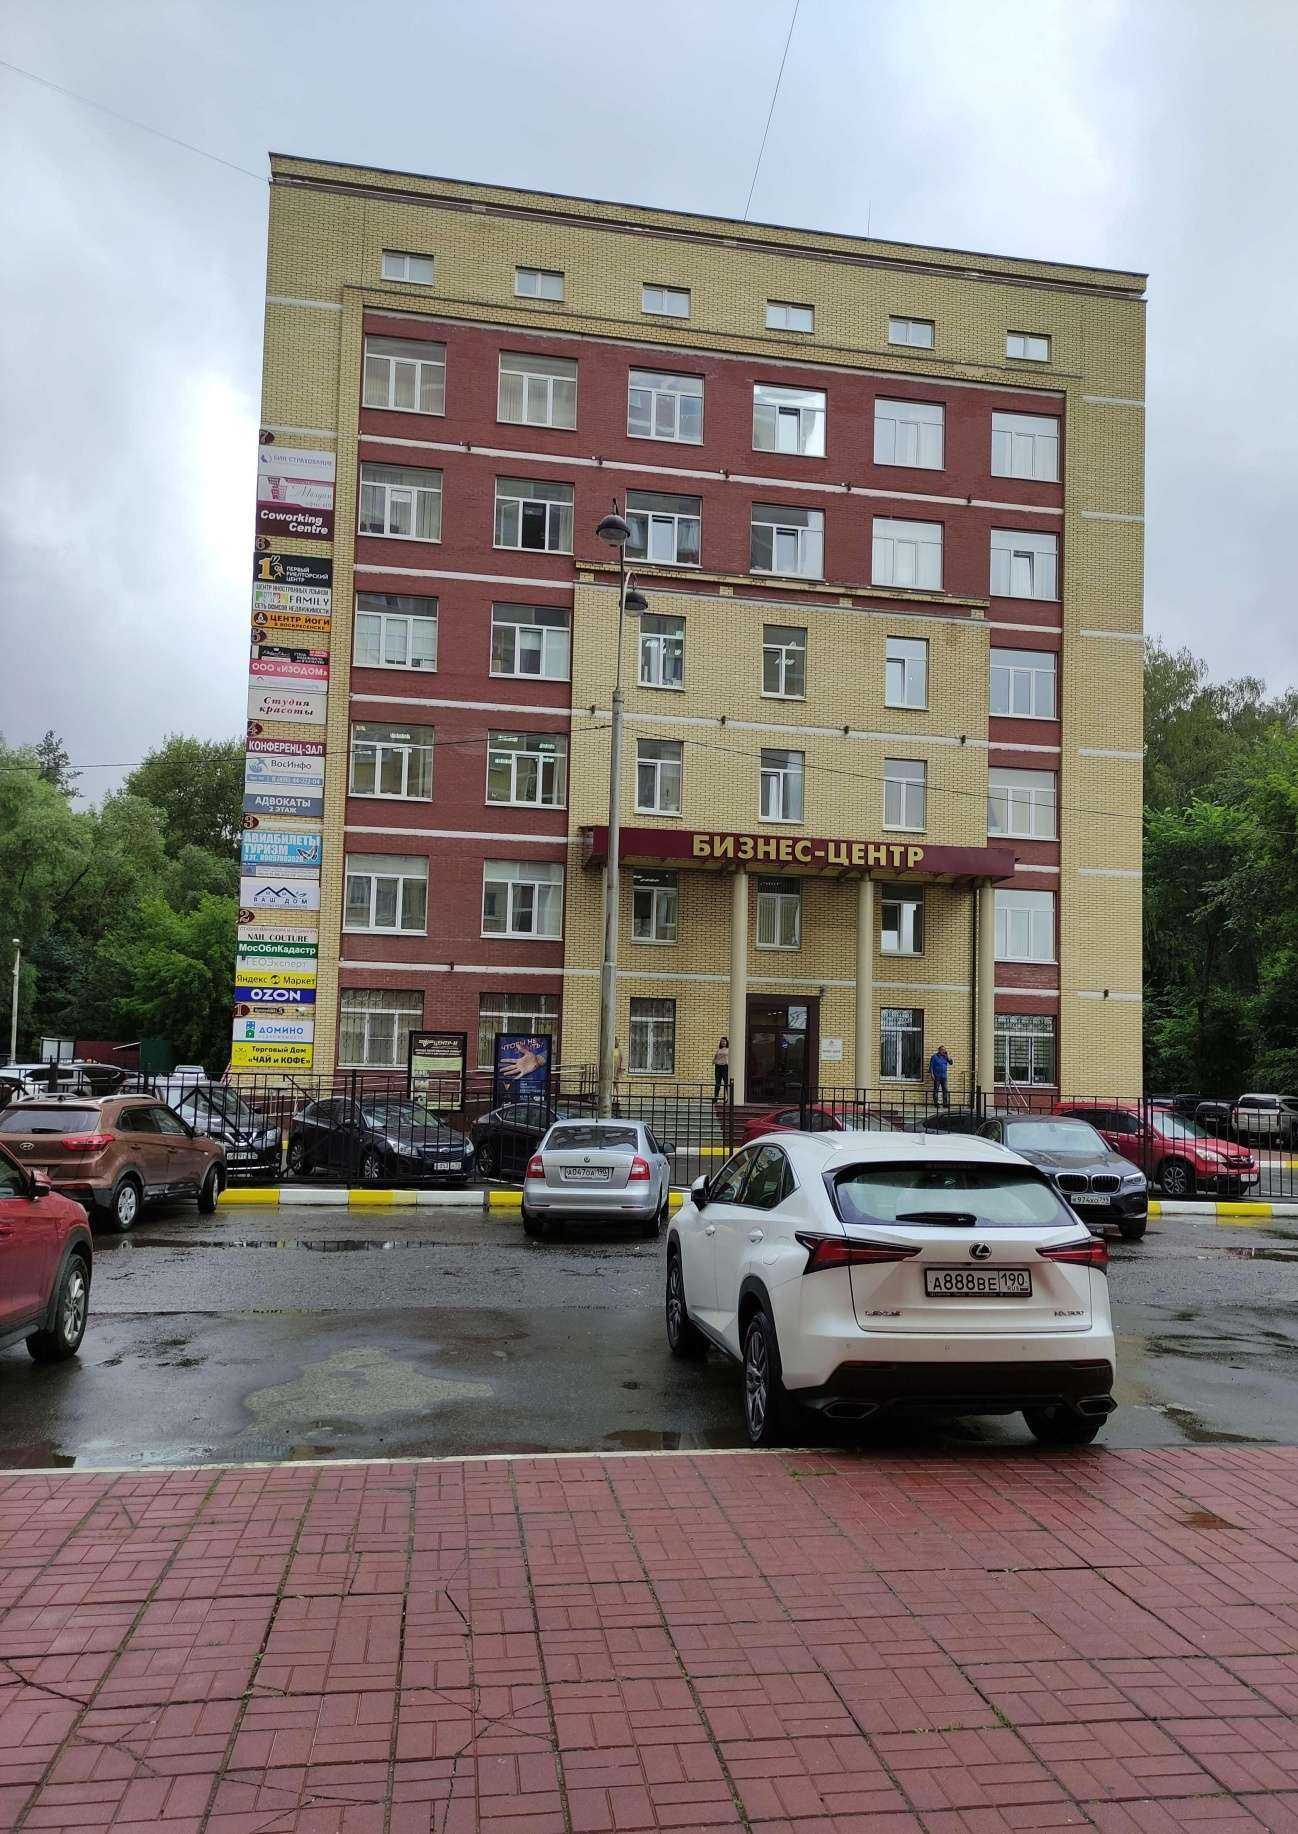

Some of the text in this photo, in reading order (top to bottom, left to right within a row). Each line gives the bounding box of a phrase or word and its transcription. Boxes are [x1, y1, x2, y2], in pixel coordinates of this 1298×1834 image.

[260, 510, 323, 526] Coworking
[289, 522, 328, 534] Centre
[286, 565, 310, 573] ПЕРВЫЙ
[289, 595, 329, 606] FAMILY
[270, 614, 301, 623] ЦЕНТР
[252, 662, 274, 672] ООО
[264, 696, 310, 707] Студия
[260, 706, 313, 716] красоты
[249, 741, 323, 755] КОНФЕРЕНЦ-ЗАЛ
[271, 760, 312, 771] ВосИнфо
[255, 796, 311, 808] АДВОКАТЫ
[243, 832, 320, 846] АВИАБИЛЕТЫ
[243, 843, 288, 855] ТУРИЗМ
[692, 834, 924, 867] БИЗНЕС-ЦЕНТР
[248, 933, 309, 943] NAIL COUTURE
[239, 943, 316, 956] МосОблКадастр
[237, 974, 315, 986] Яндекс Маркет
[250, 988, 301, 1001] OZON
[259, 1026, 304, 1035] ДОМИНО
[252, 1045, 307, 1054] Торговый Дом
[248, 1054, 271, 1064] «ЧАЙ
[280, 1056, 311, 1064] КОФЕ»
[933, 1272, 1025, 1291] А888ВЕ 190
